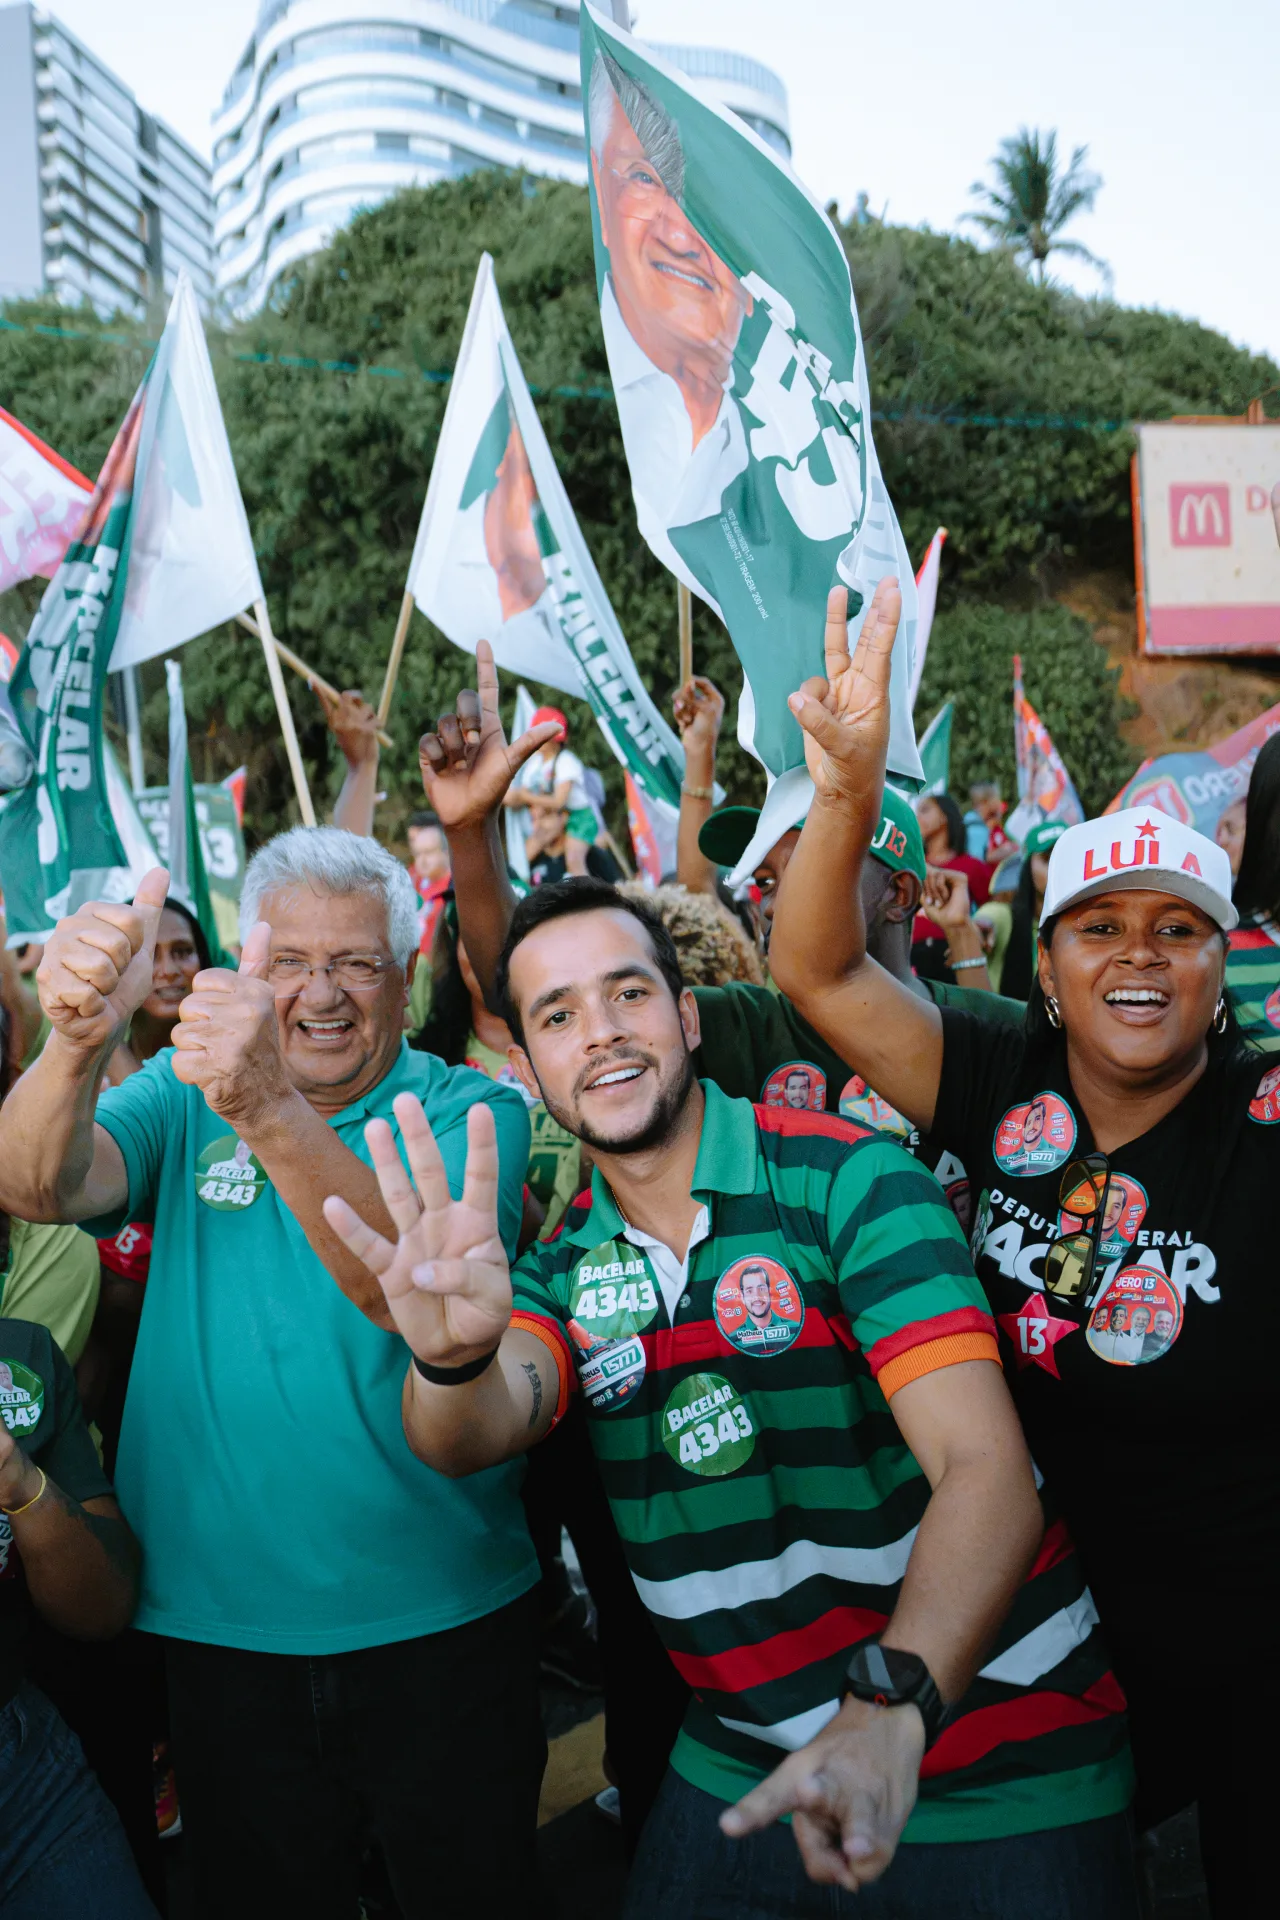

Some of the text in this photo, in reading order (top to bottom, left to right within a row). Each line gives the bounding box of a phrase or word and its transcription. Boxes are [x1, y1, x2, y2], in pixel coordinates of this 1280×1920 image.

[207, 1164, 257, 1181] BACELAR
[198, 1180, 257, 1205] 4343
[990, 1188, 1061, 1241] DEPUT
[1136, 1230, 1194, 1247] ERAL
[578, 1259, 646, 1286] BACELAR
[1115, 1276, 1156, 1289] JERO 13
[575, 1280, 659, 1320] 4343
[737, 1330, 763, 1338] Matheus
[765, 1327, 787, 1339] 15777
[1016, 1316, 1049, 1356] 13
[602, 1347, 637, 1374] 15777
[0, 1391, 31, 1404] CELAR
[667, 1384, 734, 1433] BACELAR
[1, 1402, 41, 1431] 343
[680, 1404, 753, 1465] 4343
